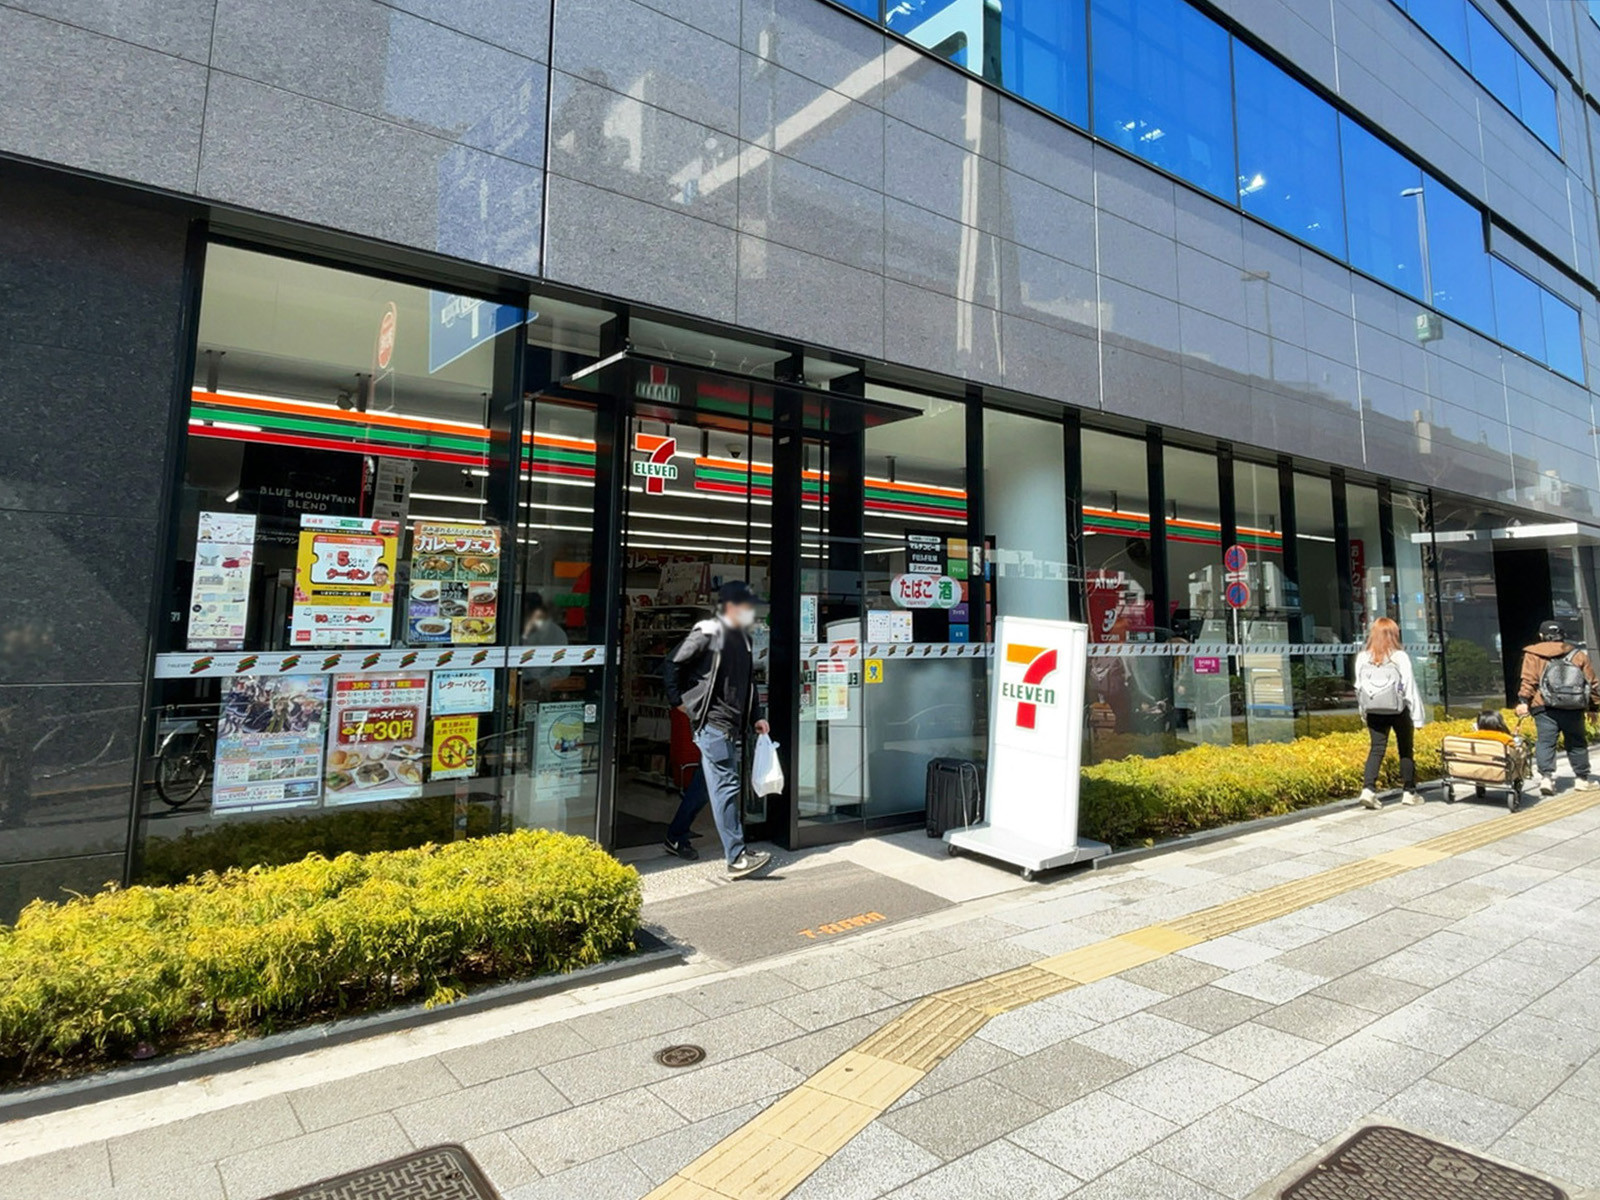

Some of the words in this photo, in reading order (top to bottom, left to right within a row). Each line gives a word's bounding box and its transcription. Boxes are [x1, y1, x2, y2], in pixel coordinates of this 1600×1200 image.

[260, 486, 292, 498] BLUE
[295, 490, 356, 504] MOUNTAIN
[287, 500, 327, 511] BLEND
[415, 536, 499, 553] カレーフェス
[326, 568, 370, 580] クーポン
[900, 579, 933, 599] たばこ
[939, 581, 953, 600] 酒
[439, 680, 487, 690] レターパック
